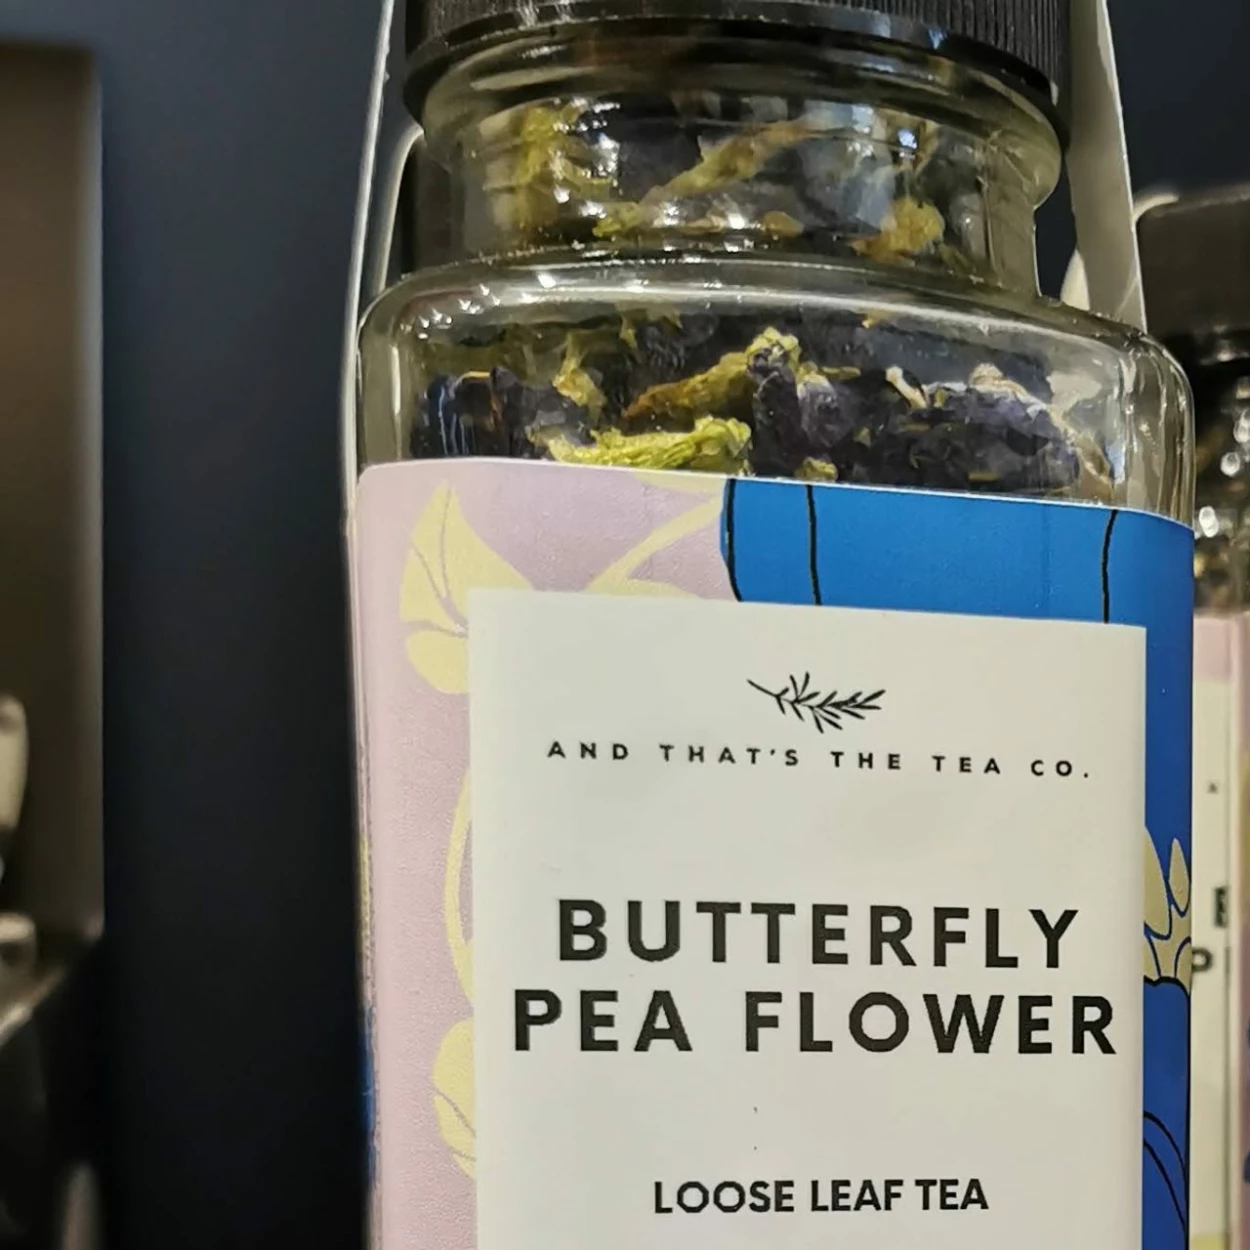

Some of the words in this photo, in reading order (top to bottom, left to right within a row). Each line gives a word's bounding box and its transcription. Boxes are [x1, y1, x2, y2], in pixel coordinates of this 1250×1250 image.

[548, 742, 628, 759] AND
[660, 745, 798, 766] THAT'S
[831, 752, 900, 769] THE
[933, 756, 1000, 774] TEA
[1031, 760, 1088, 777] CO.
[559, 899, 1078, 968] BUTTERFLY
[515, 989, 692, 1052] PEA
[746, 991, 1116, 1054] FLOWER
[655, 1180, 794, 1213] LOOSE
[811, 1180, 903, 1211] LEAF
[915, 1179, 989, 1210] TEA
